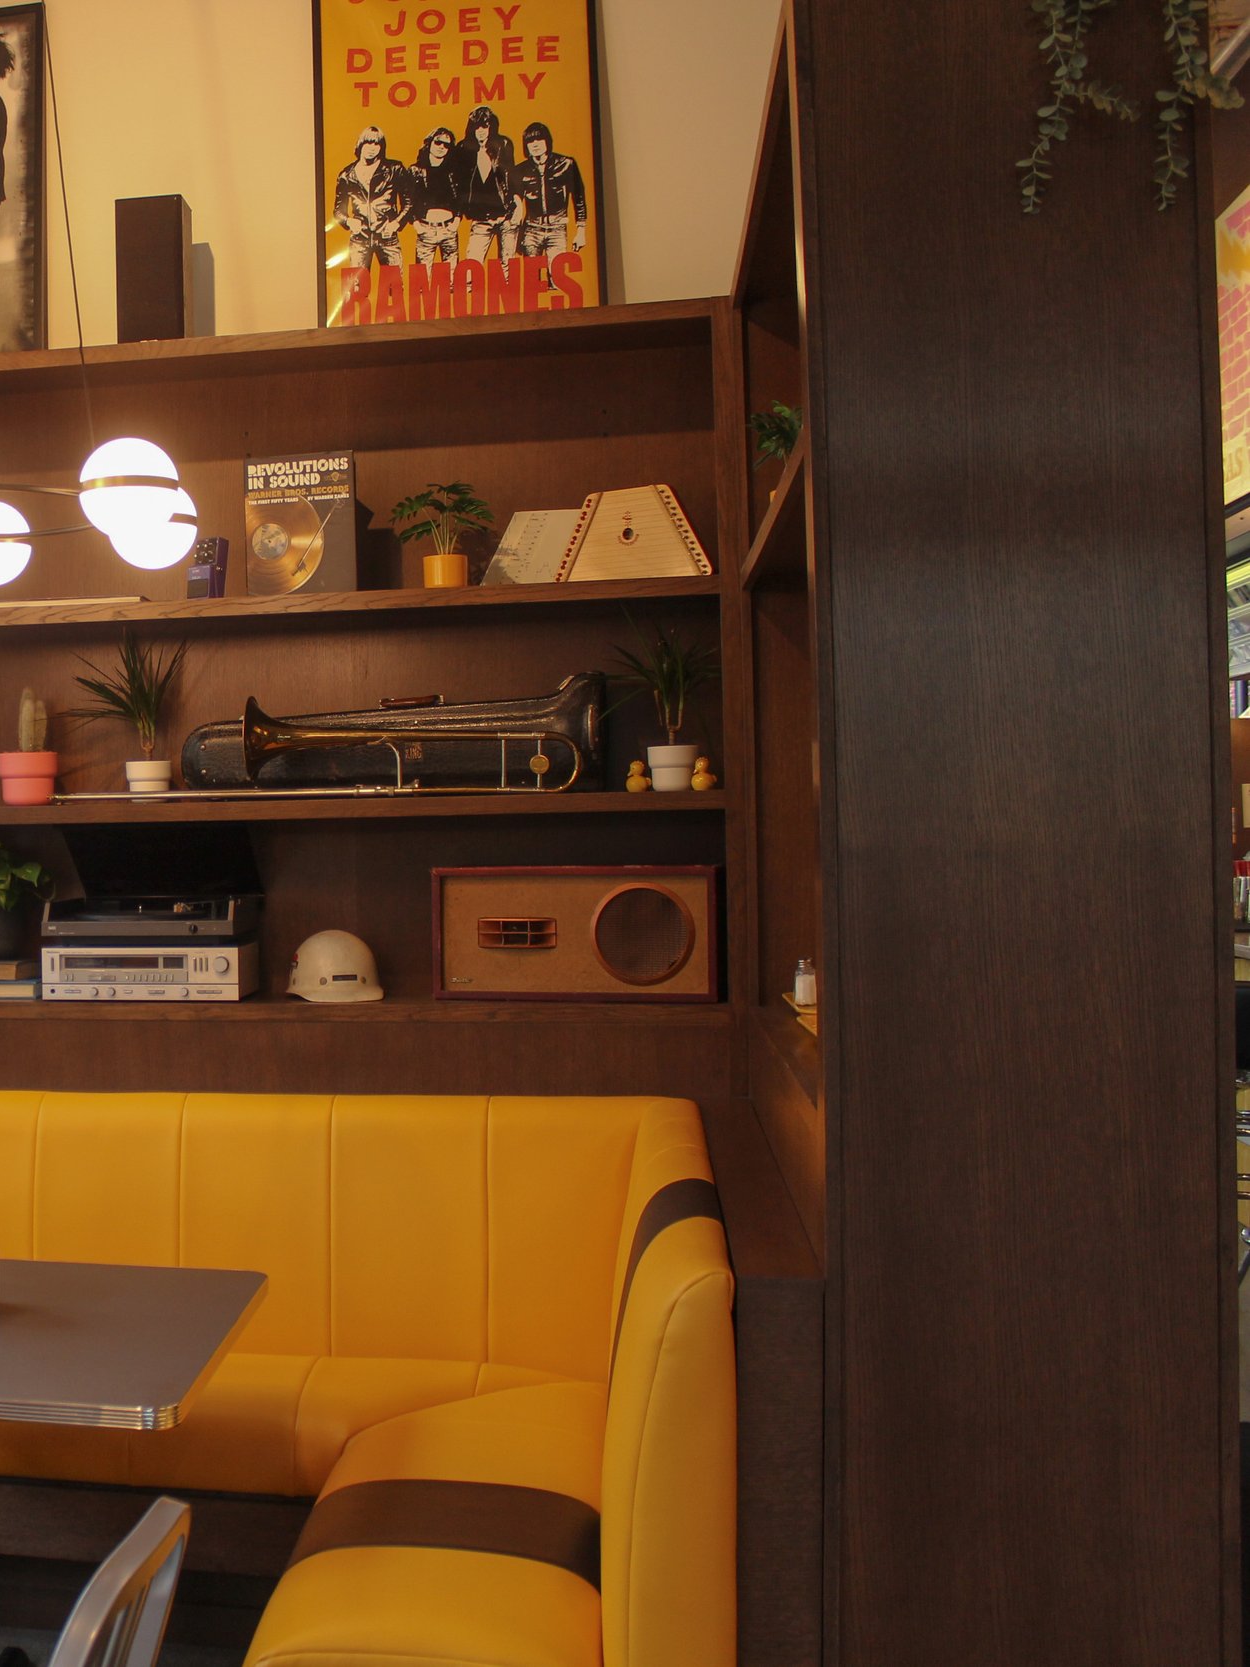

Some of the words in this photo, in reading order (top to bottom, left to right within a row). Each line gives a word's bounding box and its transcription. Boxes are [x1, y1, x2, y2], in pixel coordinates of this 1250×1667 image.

[383, 5, 521, 37] JOEY
[346, 43, 441, 74] DEE
[462, 36, 559, 66] DEE
[354, 72, 547, 108] TOMMY
[340, 251, 584, 326] RAMONES
[247, 457, 349, 477] REVOLUTIONS
[248, 477, 264, 490] IN
[269, 473, 321, 488] SOUND
[248, 490, 282, 499] WARNER
